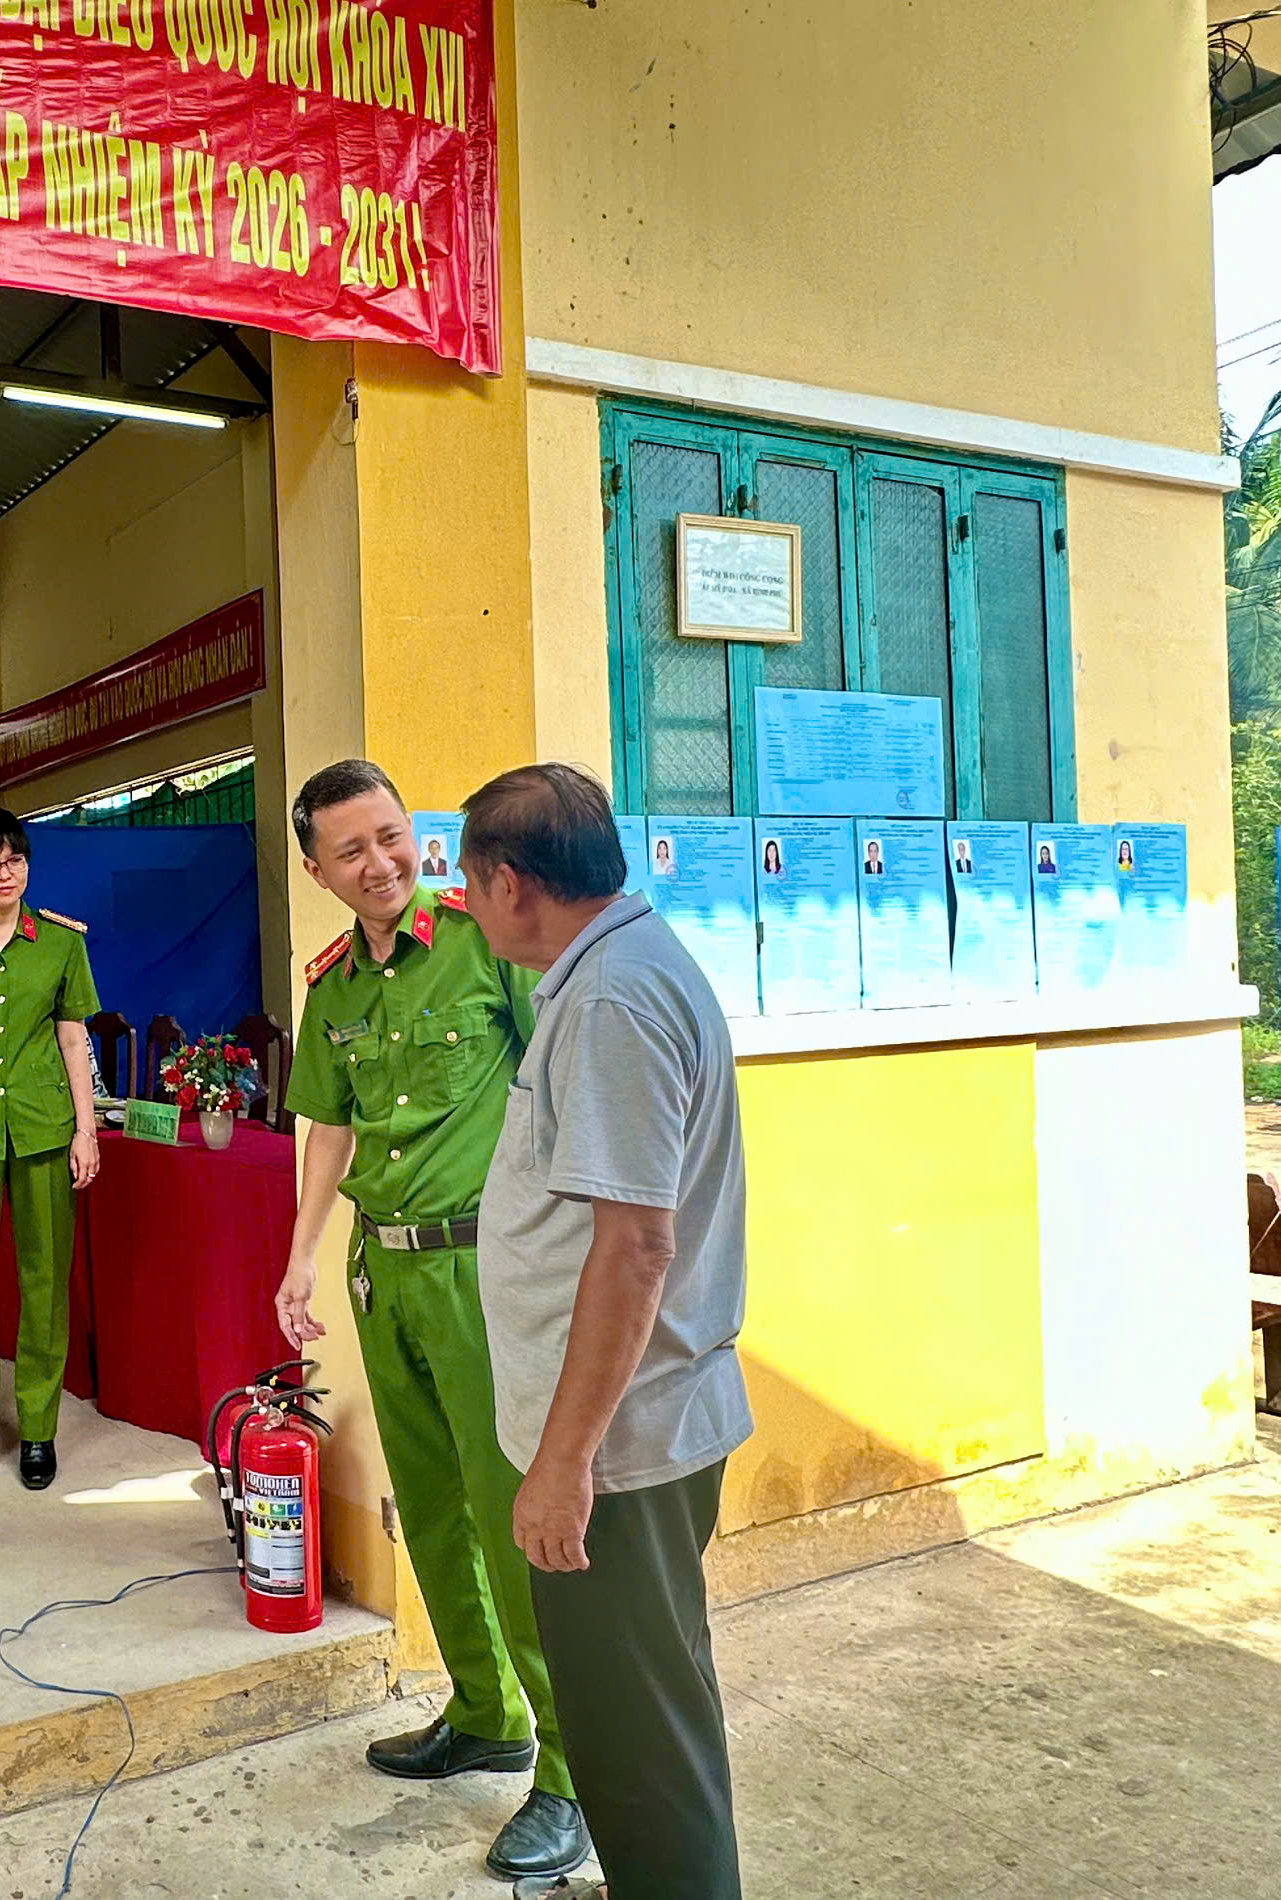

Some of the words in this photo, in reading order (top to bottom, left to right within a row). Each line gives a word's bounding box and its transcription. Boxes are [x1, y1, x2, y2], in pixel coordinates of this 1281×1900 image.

[265, 0, 321, 114] HỘI
[419, 23, 466, 132] XVI
[42, 111, 165, 267] NHIỆM
[172, 129, 215, 259] KỲ
[226, 161, 310, 277] 2026
[320, 225, 332, 247] -
